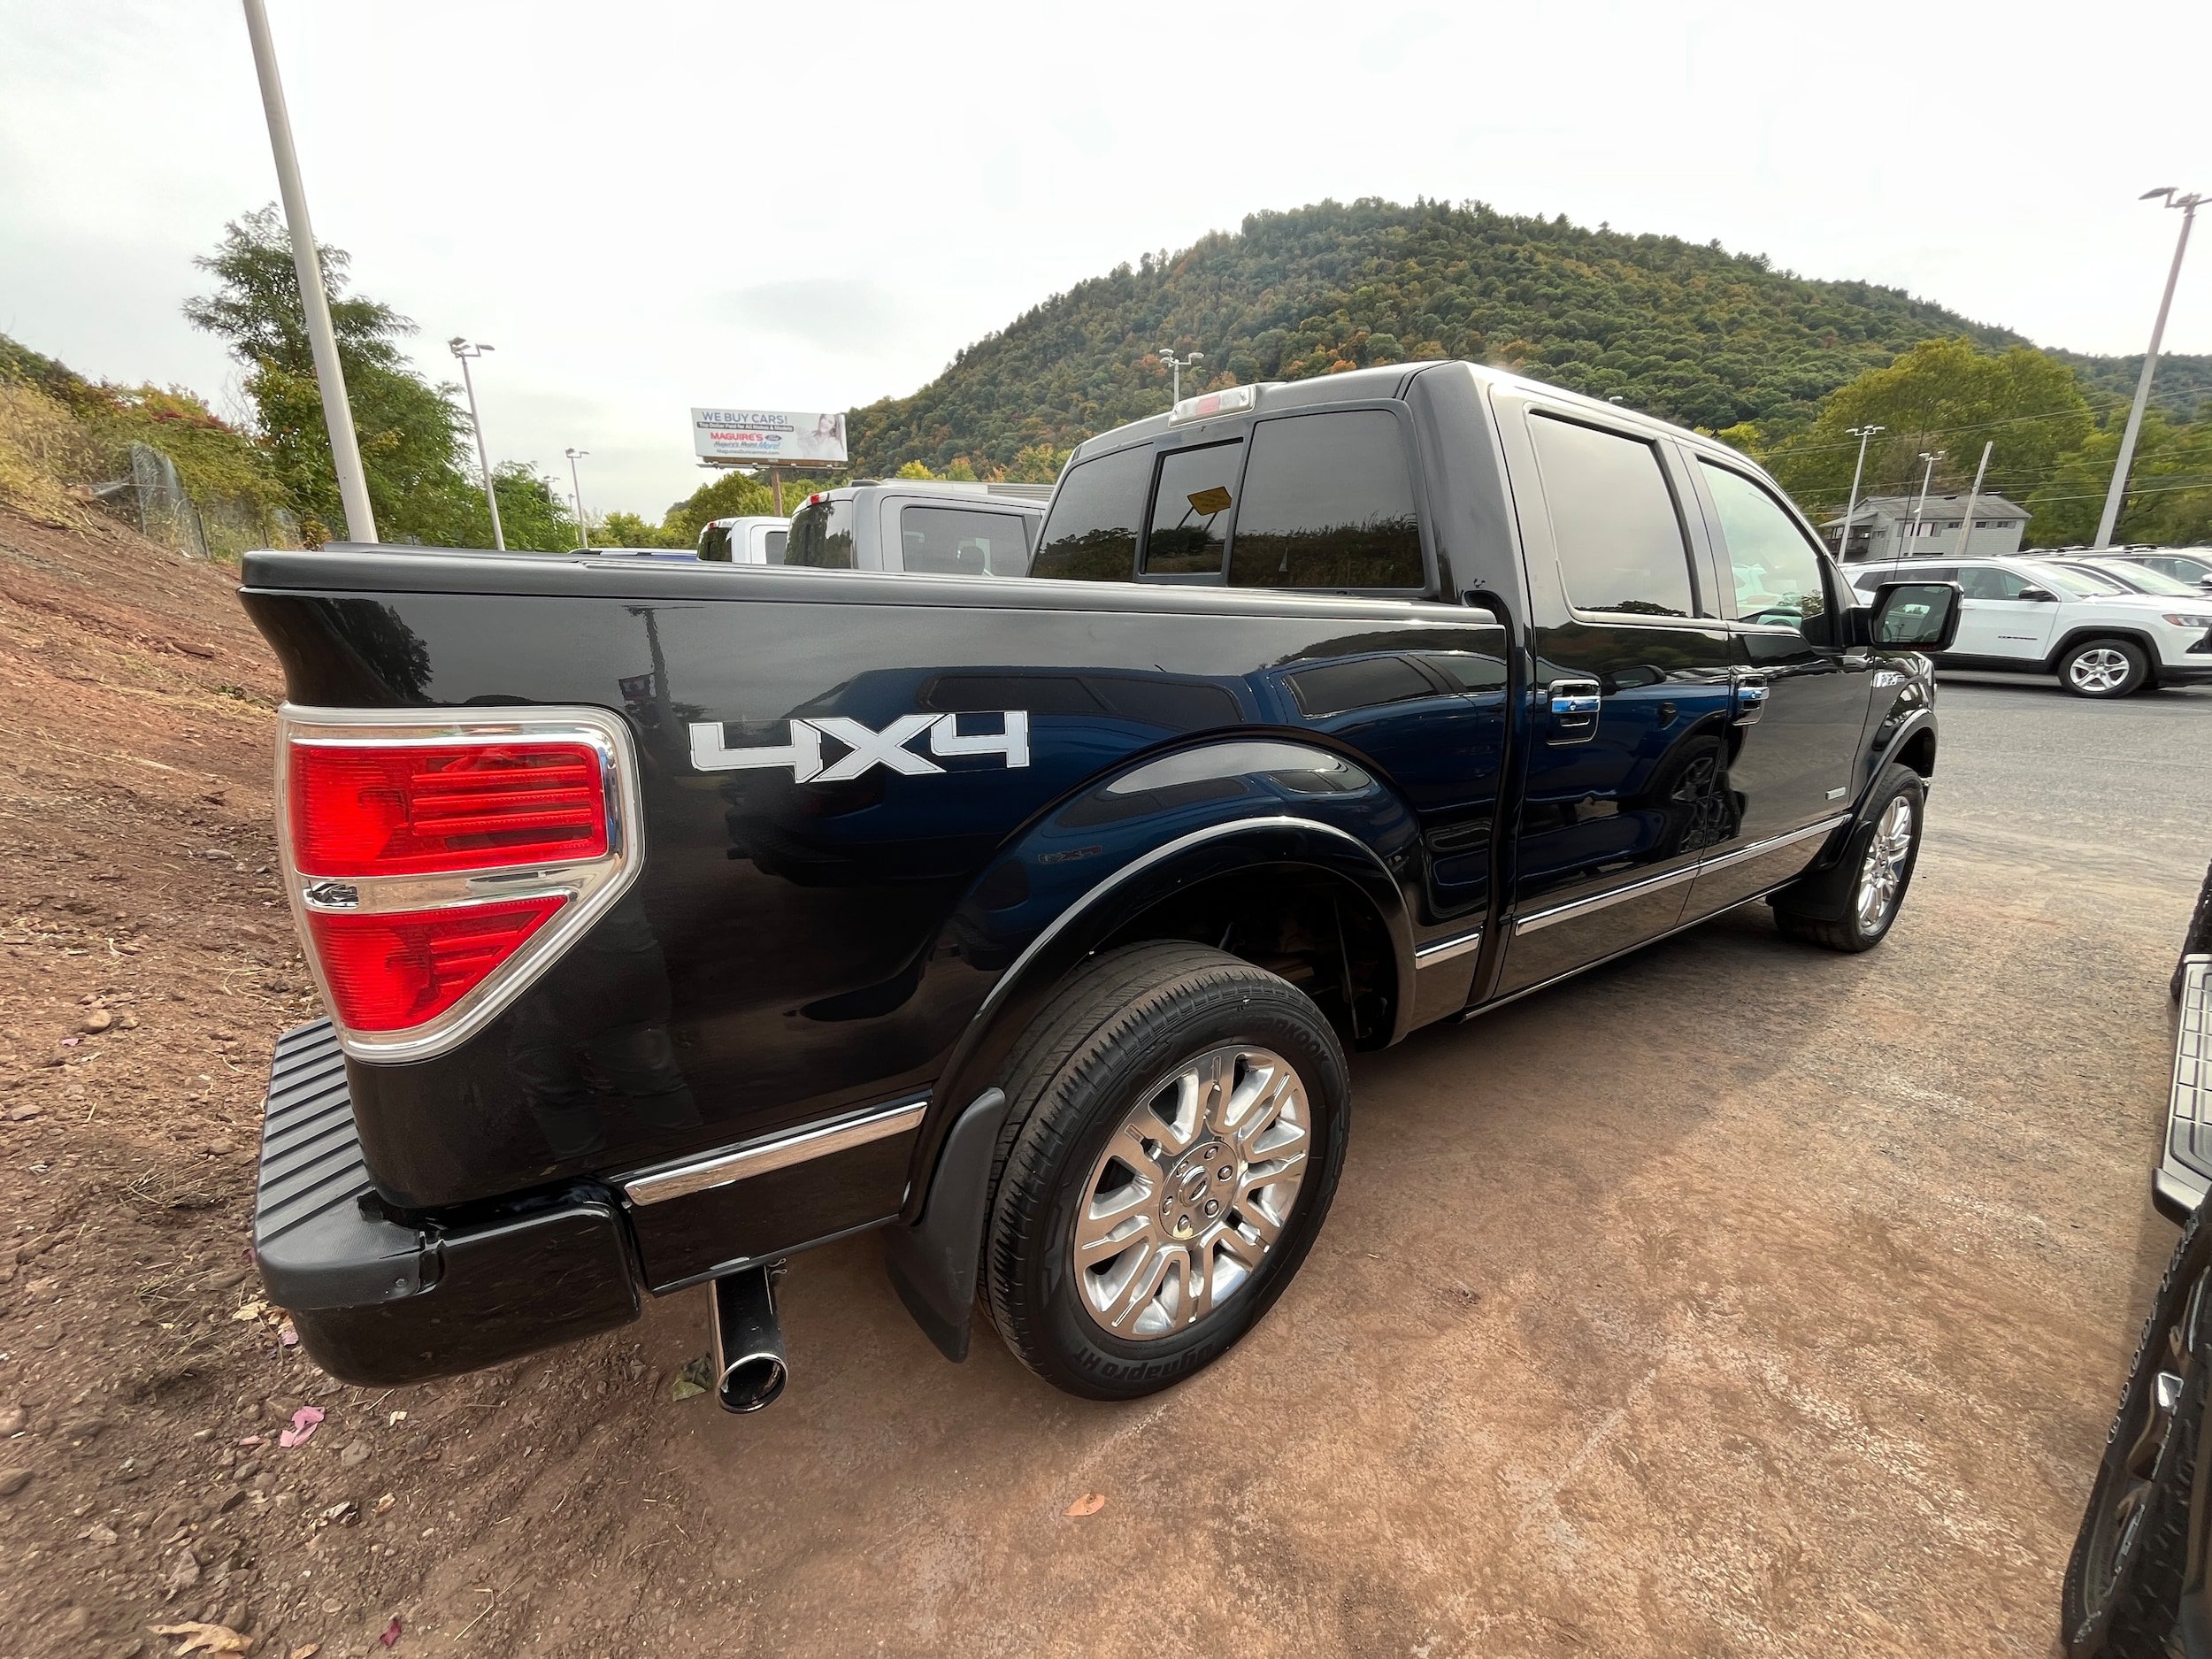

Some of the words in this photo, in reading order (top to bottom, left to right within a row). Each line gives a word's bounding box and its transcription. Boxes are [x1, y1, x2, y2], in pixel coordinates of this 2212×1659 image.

[702, 411, 721, 422] WE
[724, 412, 749, 423] BUY
[751, 413, 787, 425] CARS!
[710, 432, 764, 442] MAGUIRE'S
